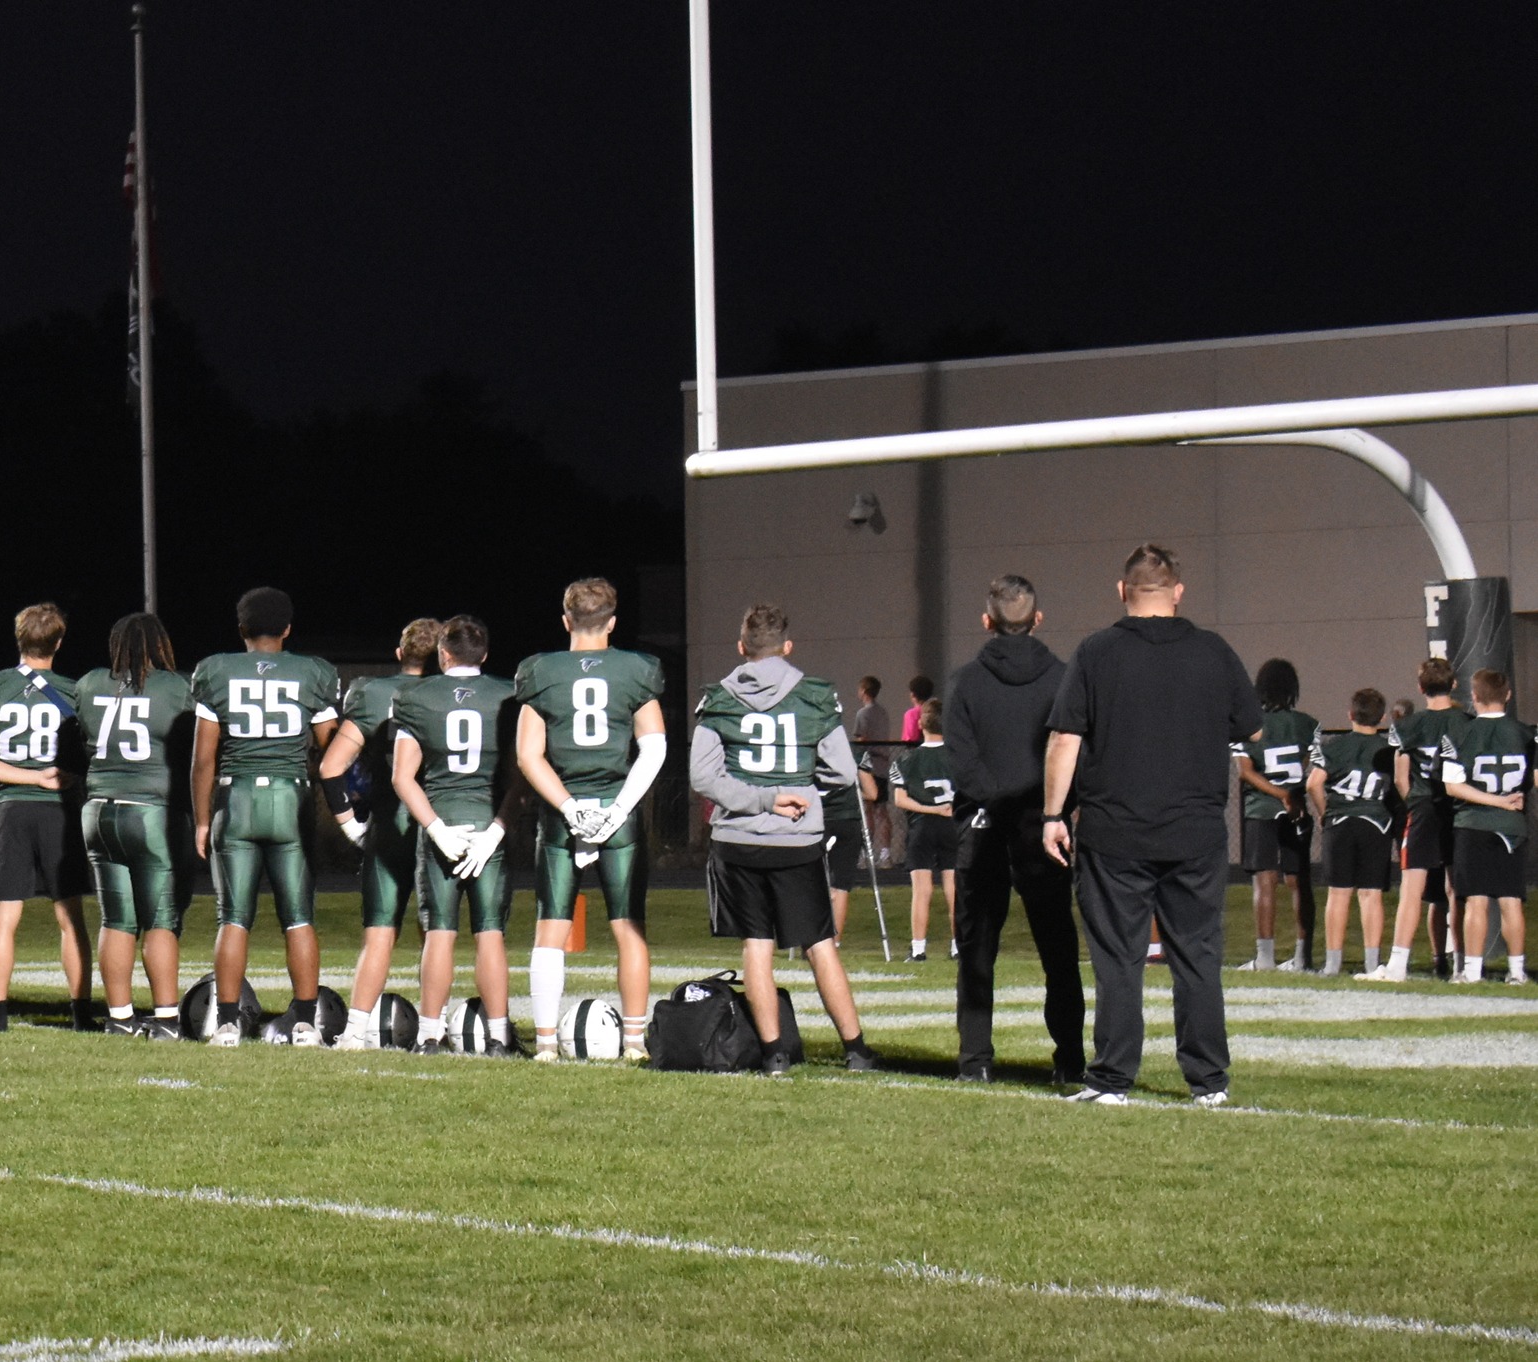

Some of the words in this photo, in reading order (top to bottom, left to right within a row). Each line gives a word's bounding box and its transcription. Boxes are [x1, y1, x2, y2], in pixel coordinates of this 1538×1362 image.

[93, 696, 151, 761] 75
[228, 679, 302, 738] 55
[572, 677, 609, 746] 8
[445, 709, 482, 774] 9
[739, 713, 798, 773] 31
[1264, 745, 1303, 785] 5
[1473, 754, 1527, 793] 52
